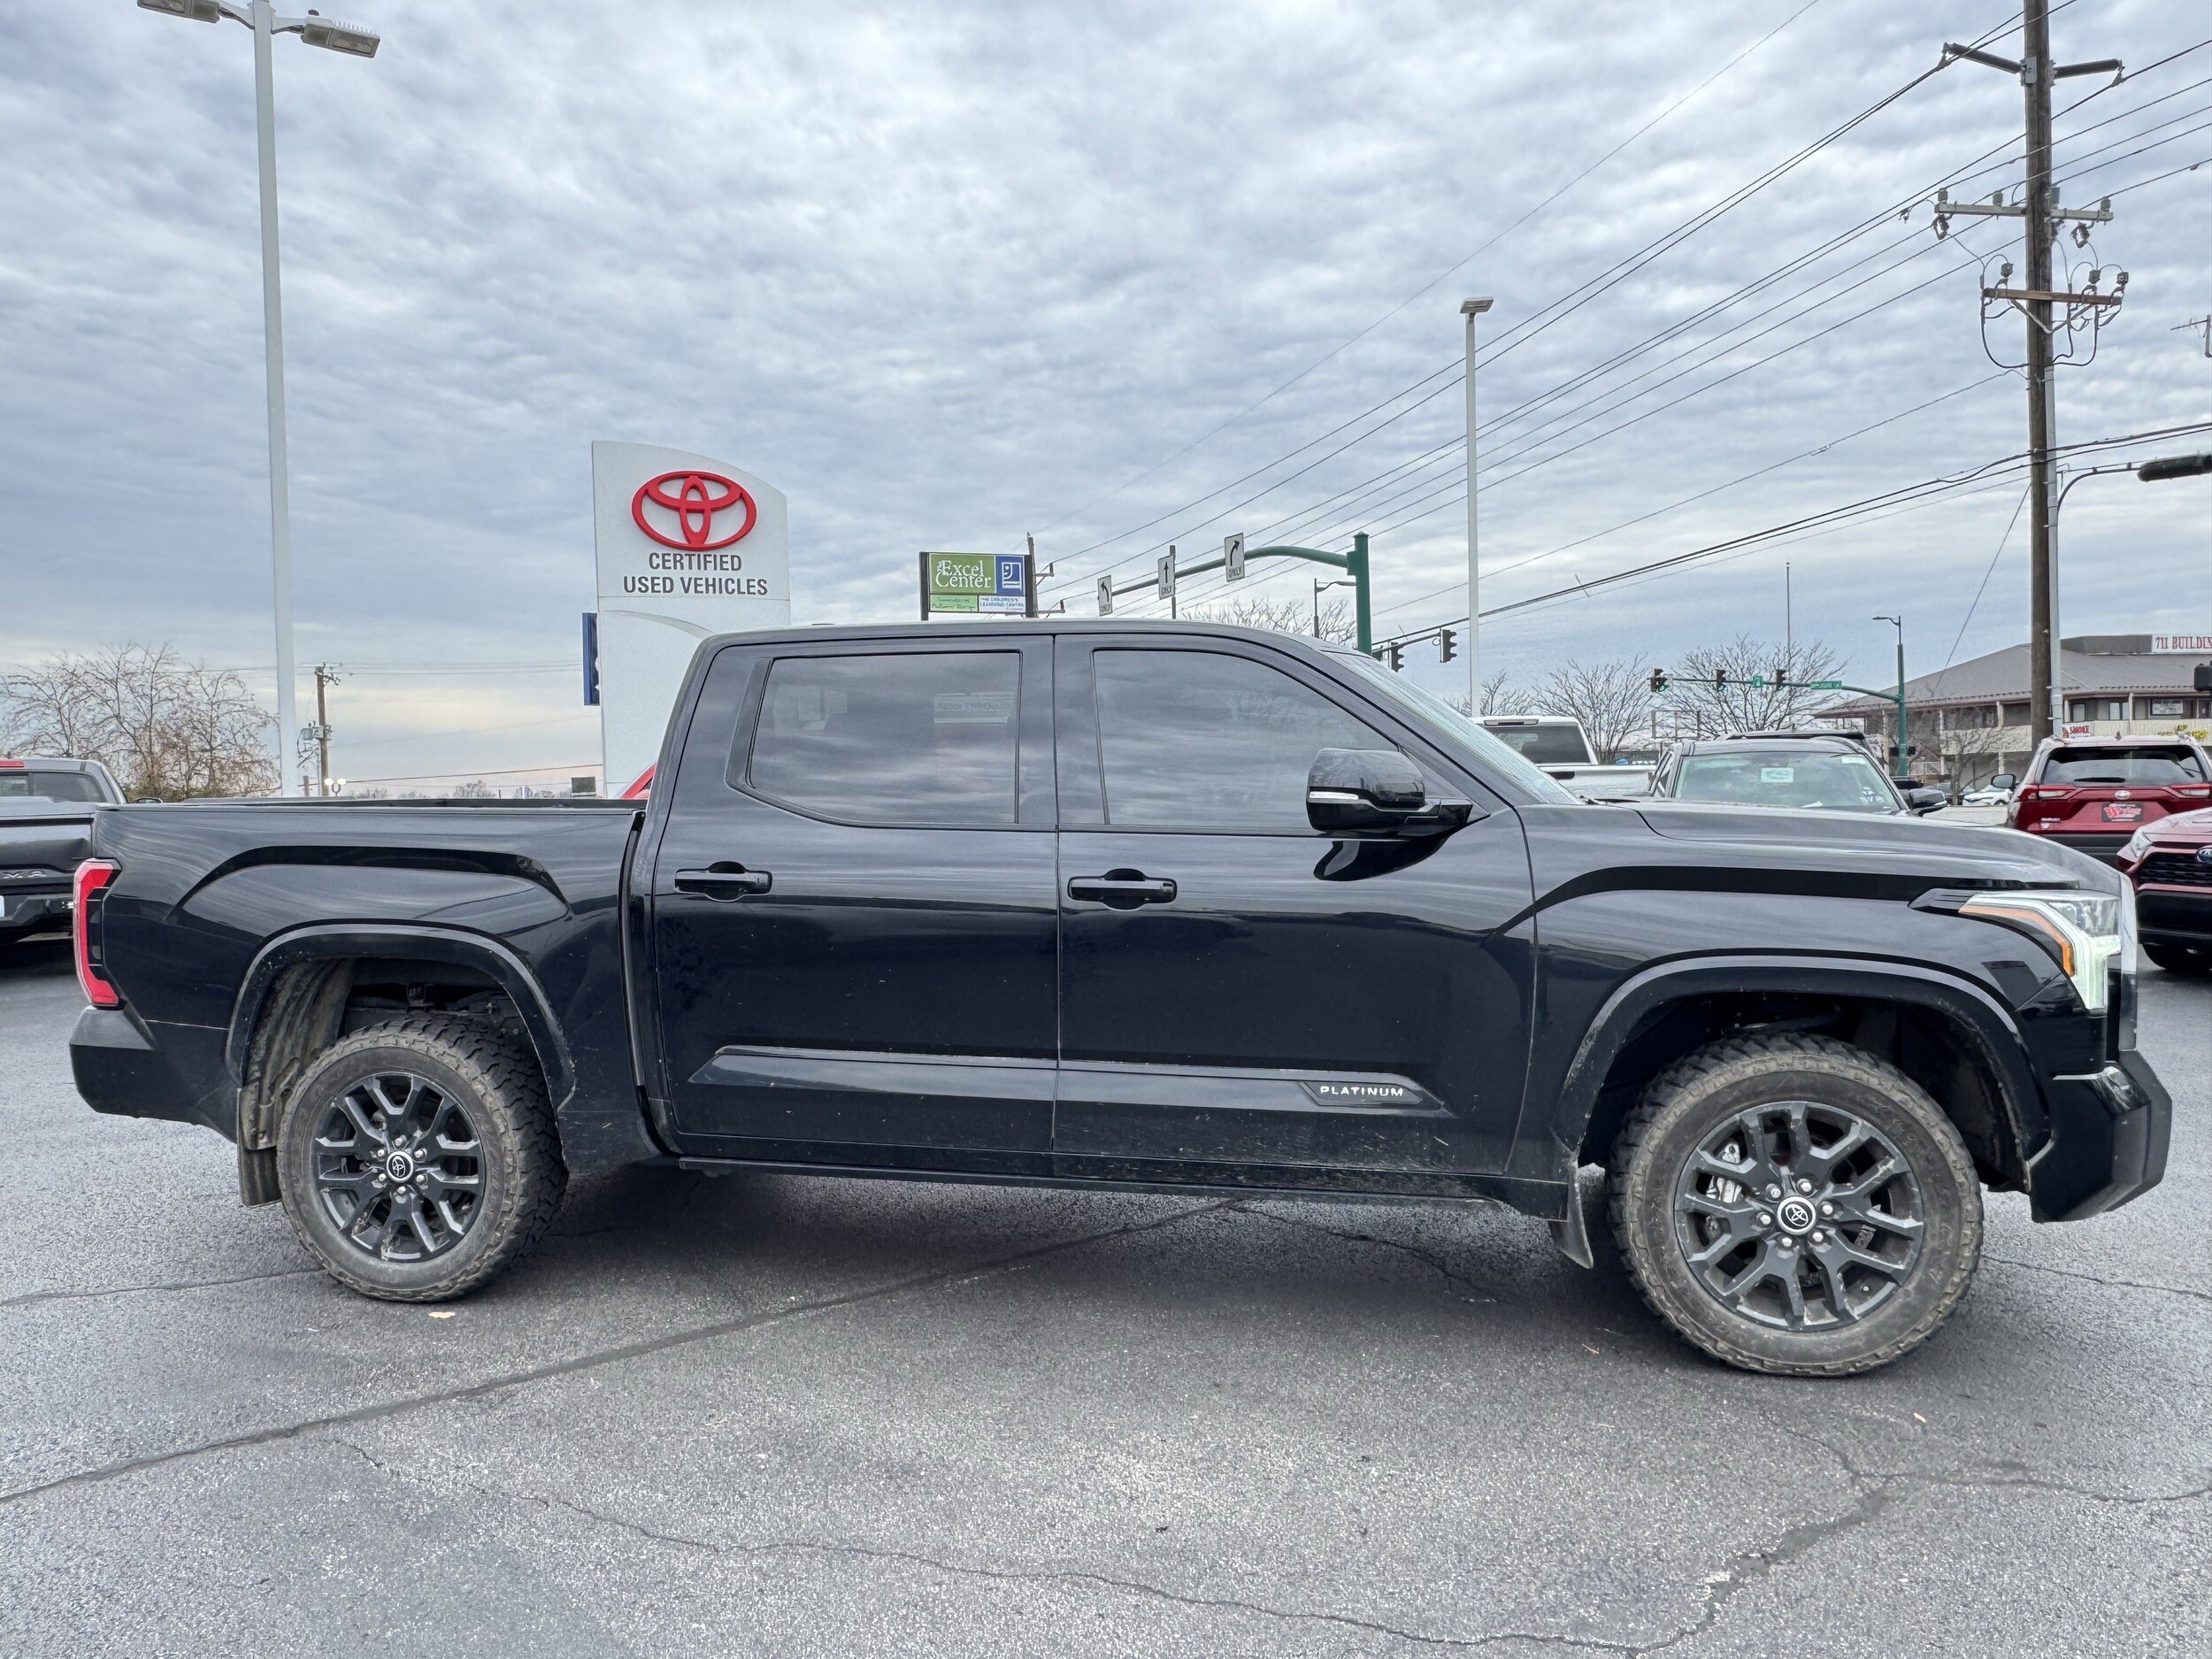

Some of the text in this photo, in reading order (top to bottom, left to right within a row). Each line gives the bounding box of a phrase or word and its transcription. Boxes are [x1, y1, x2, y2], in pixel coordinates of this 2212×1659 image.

[649, 552, 741, 571] CERTIFIED
[938, 560, 984, 577] Excel
[623, 576, 768, 595] USED VEHICLES
[935, 572, 991, 588] Center
[1320, 1086, 1403, 1096] PLATINUM
